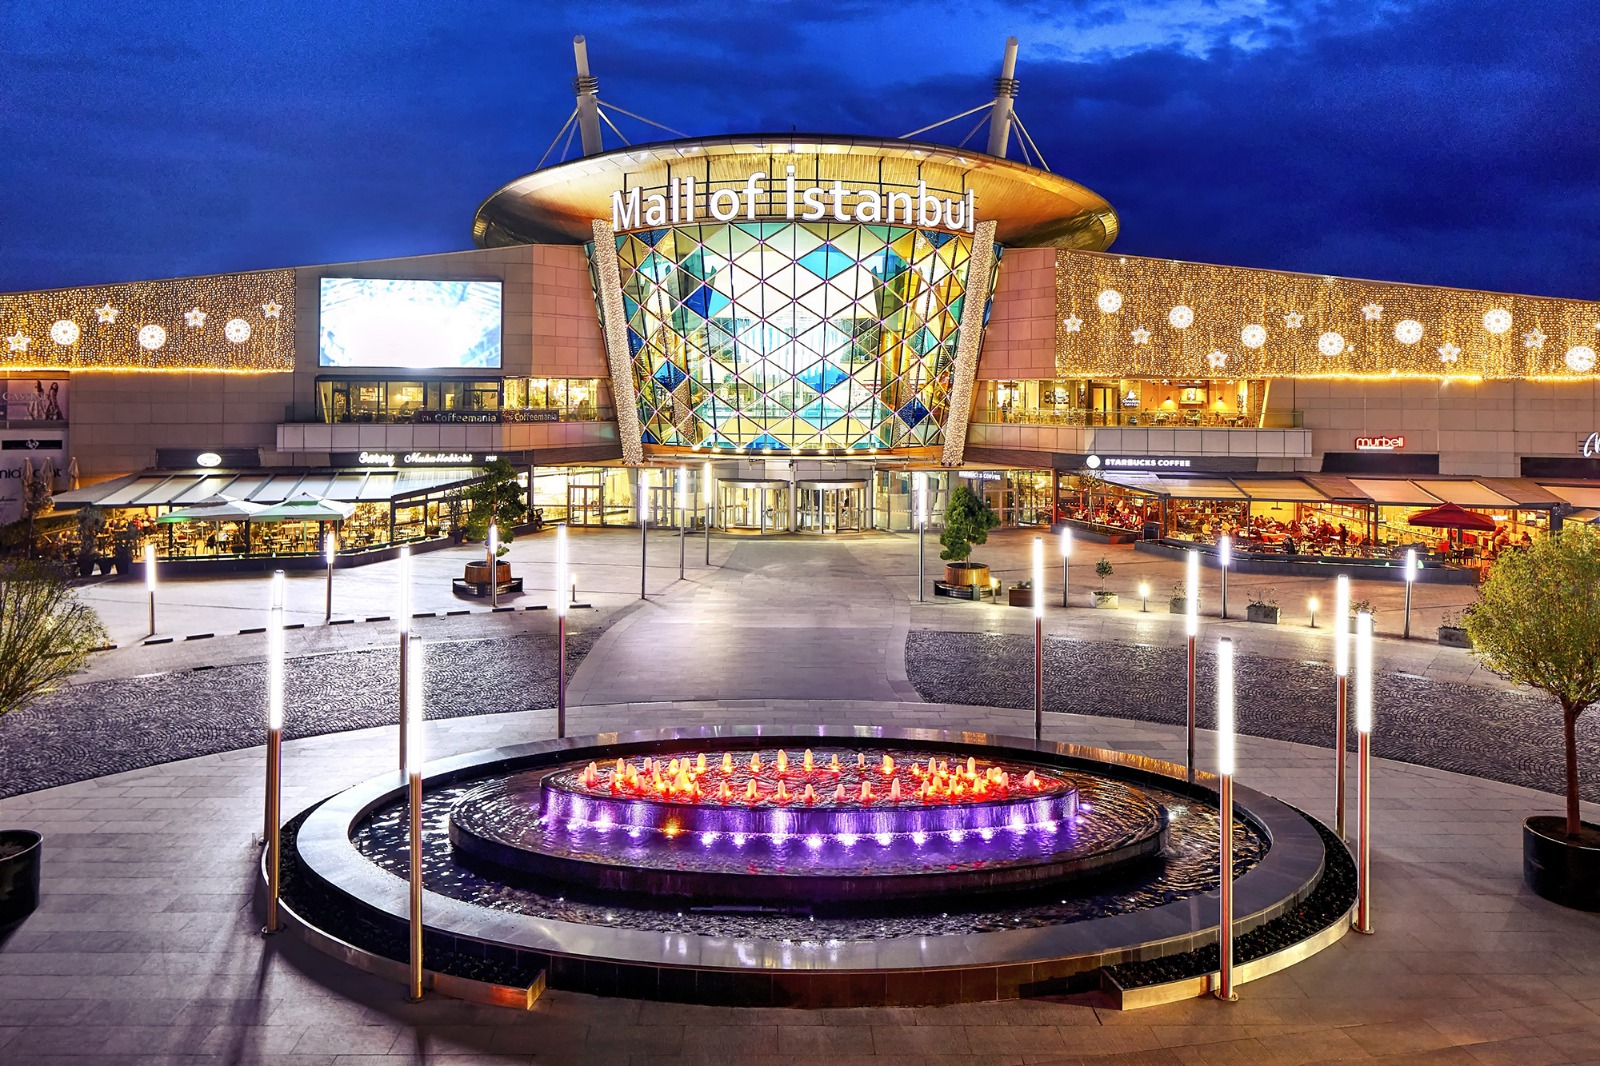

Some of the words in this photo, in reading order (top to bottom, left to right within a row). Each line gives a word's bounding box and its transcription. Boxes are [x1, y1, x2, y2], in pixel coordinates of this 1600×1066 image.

[613, 176, 696, 232] Mall
[710, 171, 767, 221] of
[434, 412, 498, 423] Coffeemania
[514, 412, 558, 422] Coffeemania
[1355, 436, 1404, 449] murbell
[1104, 458, 1157, 467] STARBUCKS
[1157, 459, 1191, 467] COFFEE
